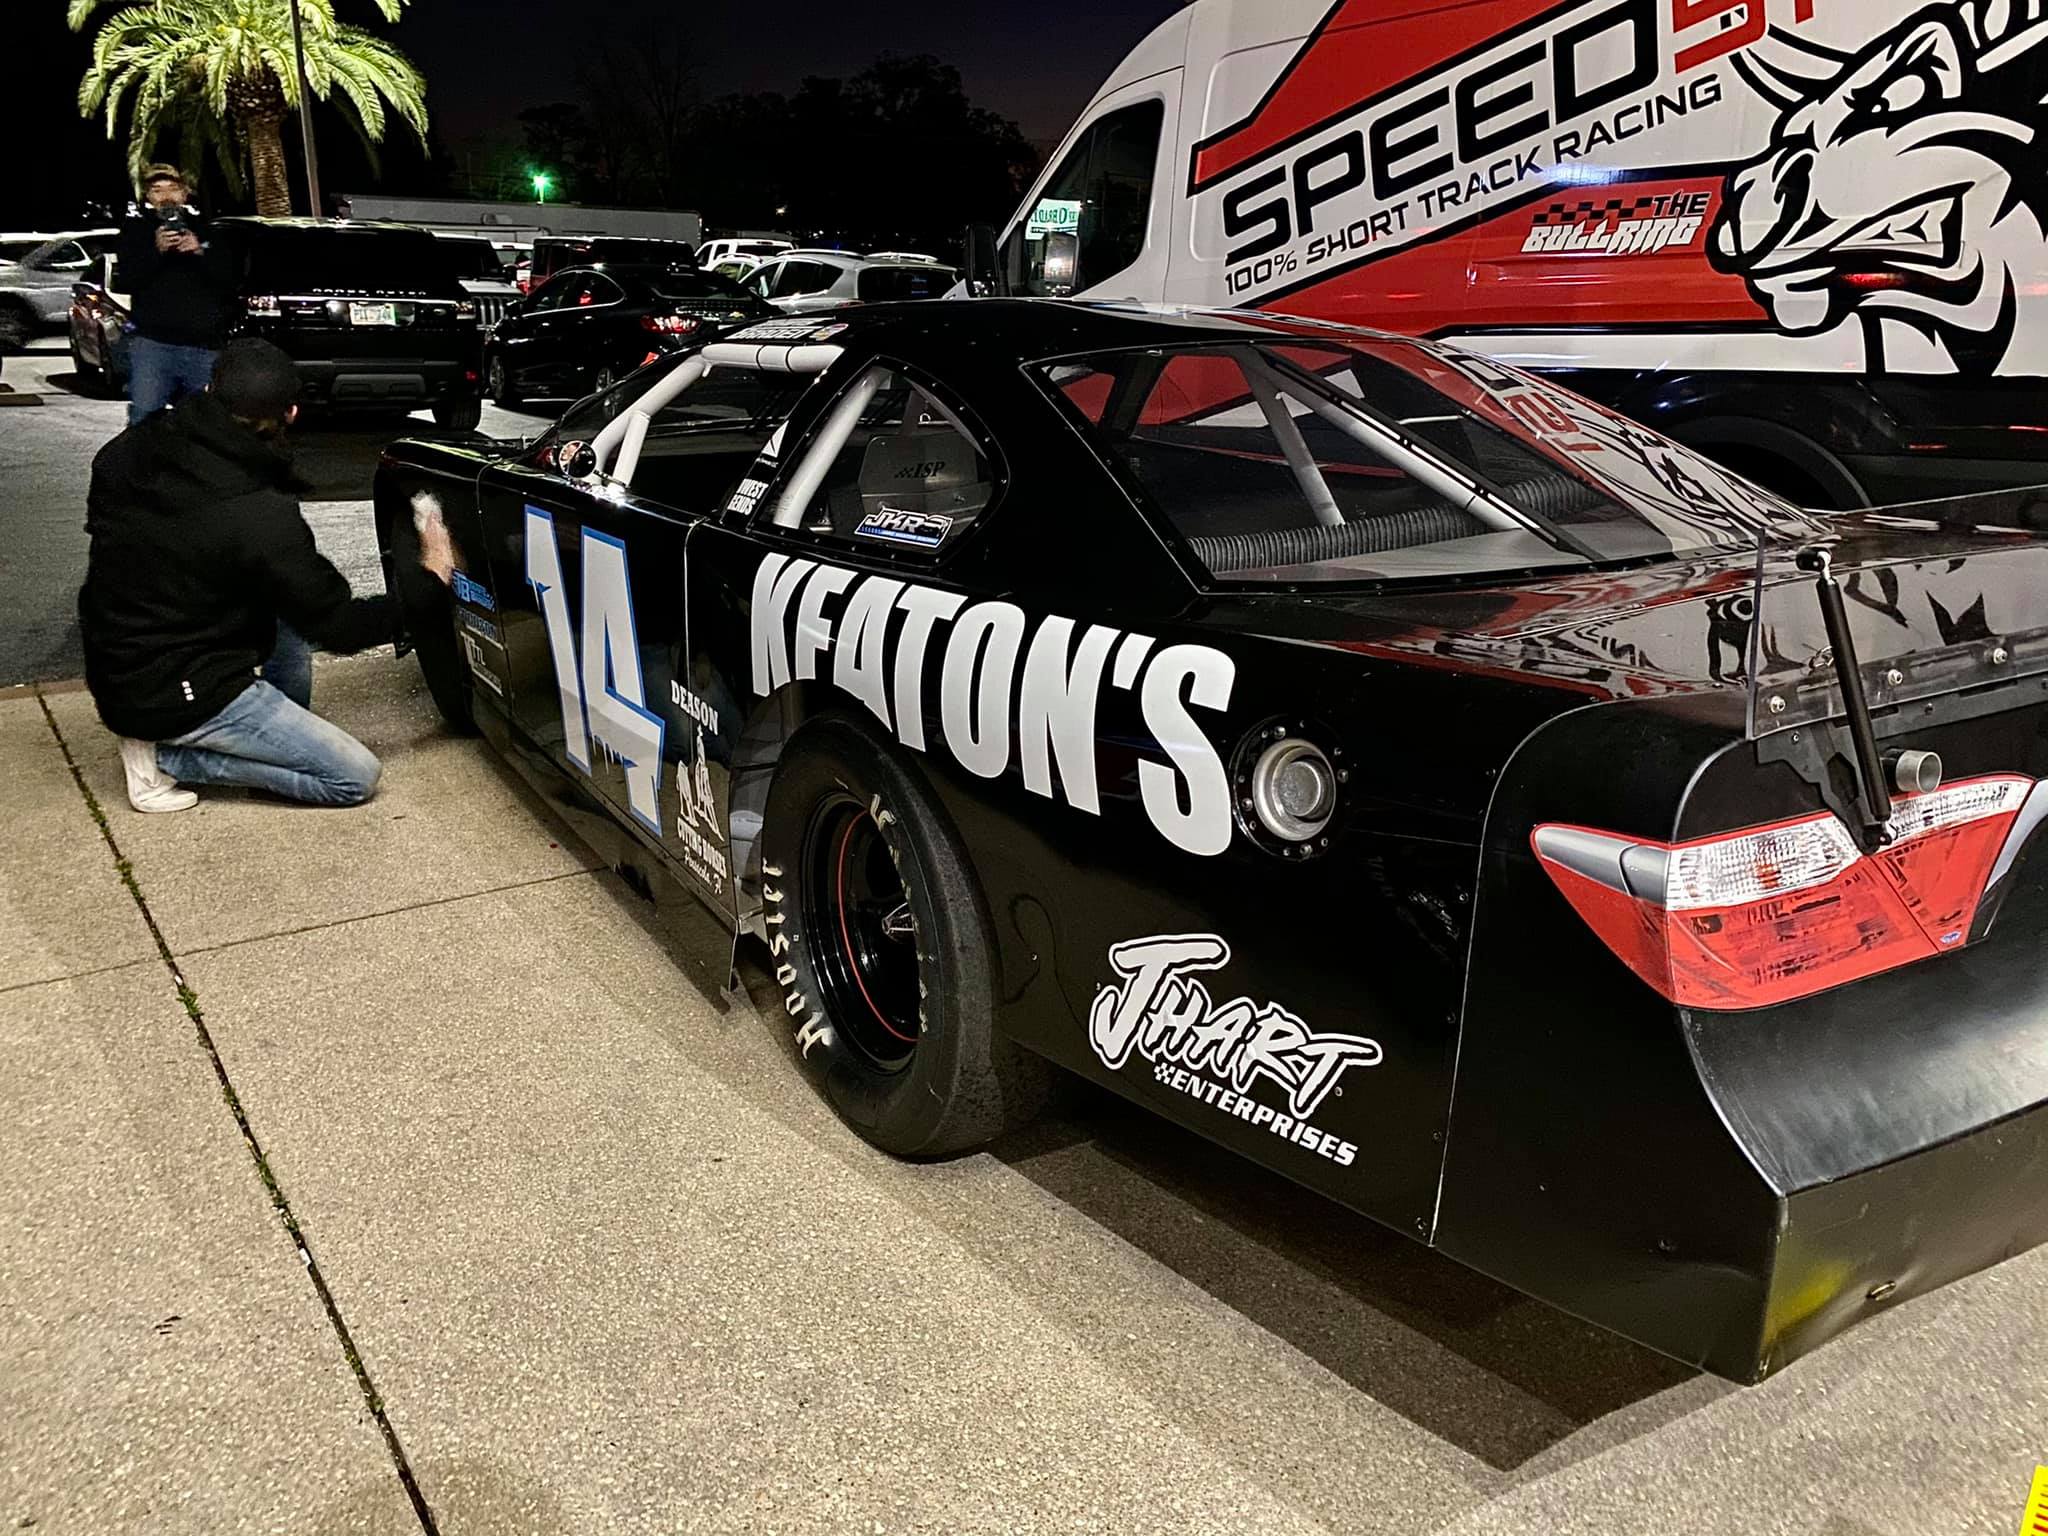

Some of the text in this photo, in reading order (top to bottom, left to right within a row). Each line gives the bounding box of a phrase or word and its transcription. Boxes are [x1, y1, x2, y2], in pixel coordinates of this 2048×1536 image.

[1225, 73, 1723, 296] 100% SHORT TRACK RACING
[1650, 190, 1712, 217] THE
[1520, 216, 1704, 256] BULLRING
[912, 461, 945, 479] ISP
[524, 504, 665, 837] 14
[671, 679, 719, 736] DEASON
[1089, 933, 1383, 1119] JHART
[1169, 1071, 1358, 1167] ENTERPRISES
